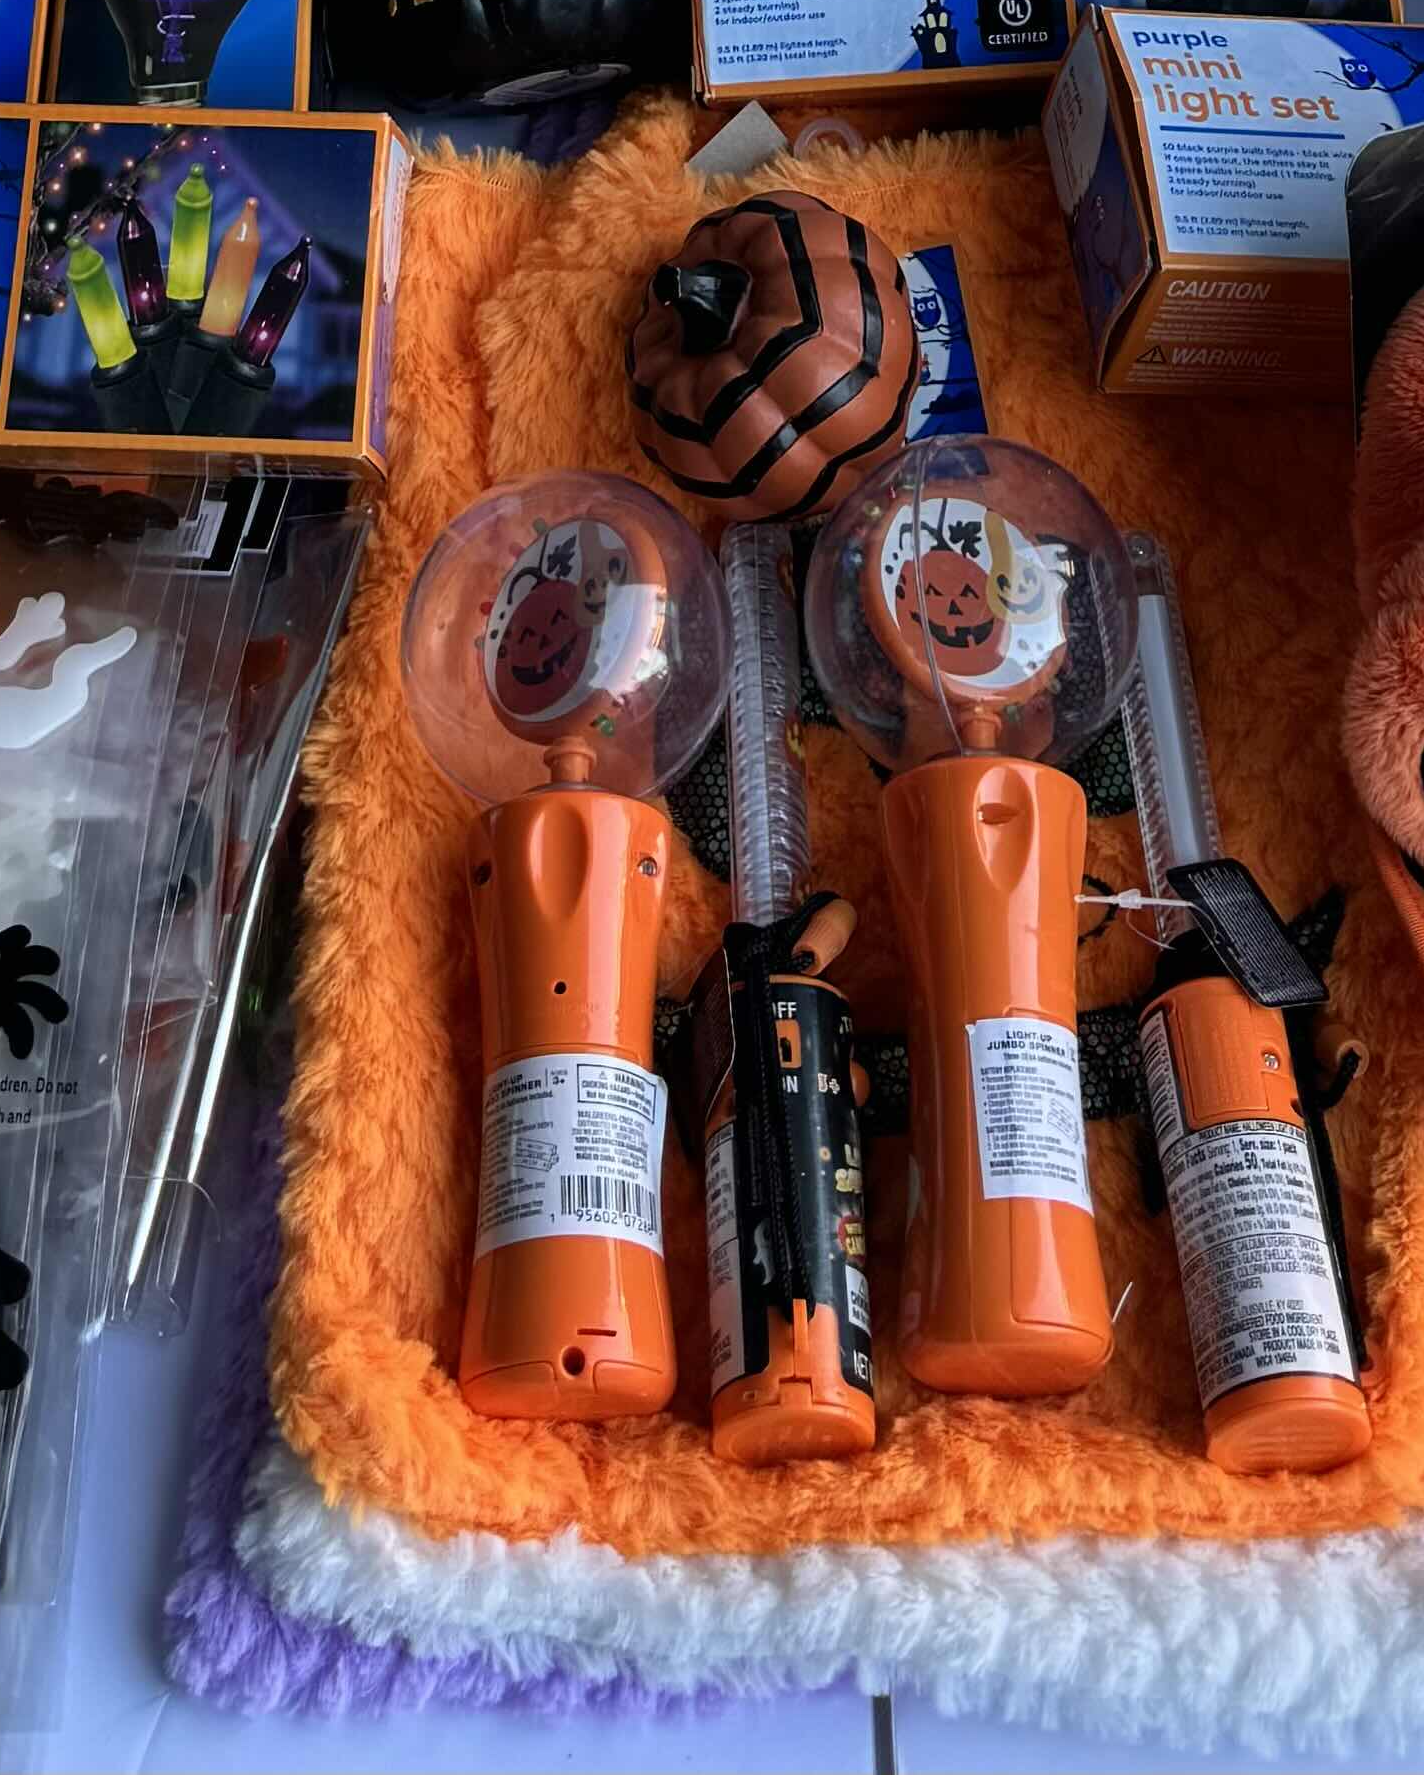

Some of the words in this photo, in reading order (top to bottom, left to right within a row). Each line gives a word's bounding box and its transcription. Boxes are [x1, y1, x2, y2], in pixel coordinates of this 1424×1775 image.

[723, 4, 754, 14] steady
[809, 11, 826, 19] use
[987, 30, 1048, 47] CERTIFIED
[1133, 29, 1228, 49] purple
[1142, 53, 1243, 80] mini
[1151, 83, 1260, 123] light
[1271, 94, 1340, 121] set
[1266, 147, 1295, 157] lights
[1196, 155, 1219, 165] goes
[1244, 157, 1260, 166] the
[1262, 158, 1295, 168] others
[1297, 159, 1317, 169] stay
[1235, 167, 1278, 177] included
[1167, 280, 1271, 299] CAUTION
[772, 1001, 797, 1018] FF
[987, 1041, 1025, 1050] JUMBO
[1029, 1042, 1065, 1057] SPINNER
[35, 1077, 53, 1094] Do
[57, 1079, 78, 1095] not
[7, 1109, 31, 1123] and
[1214, 1160, 1244, 1177] Calories
[577, 1210, 617, 1224] 95602
[1265, 1314, 1285, 1325] FOOD
[1249, 1328, 1271, 1342] STORE
[1263, 1339, 1296, 1351] PRODUCT
